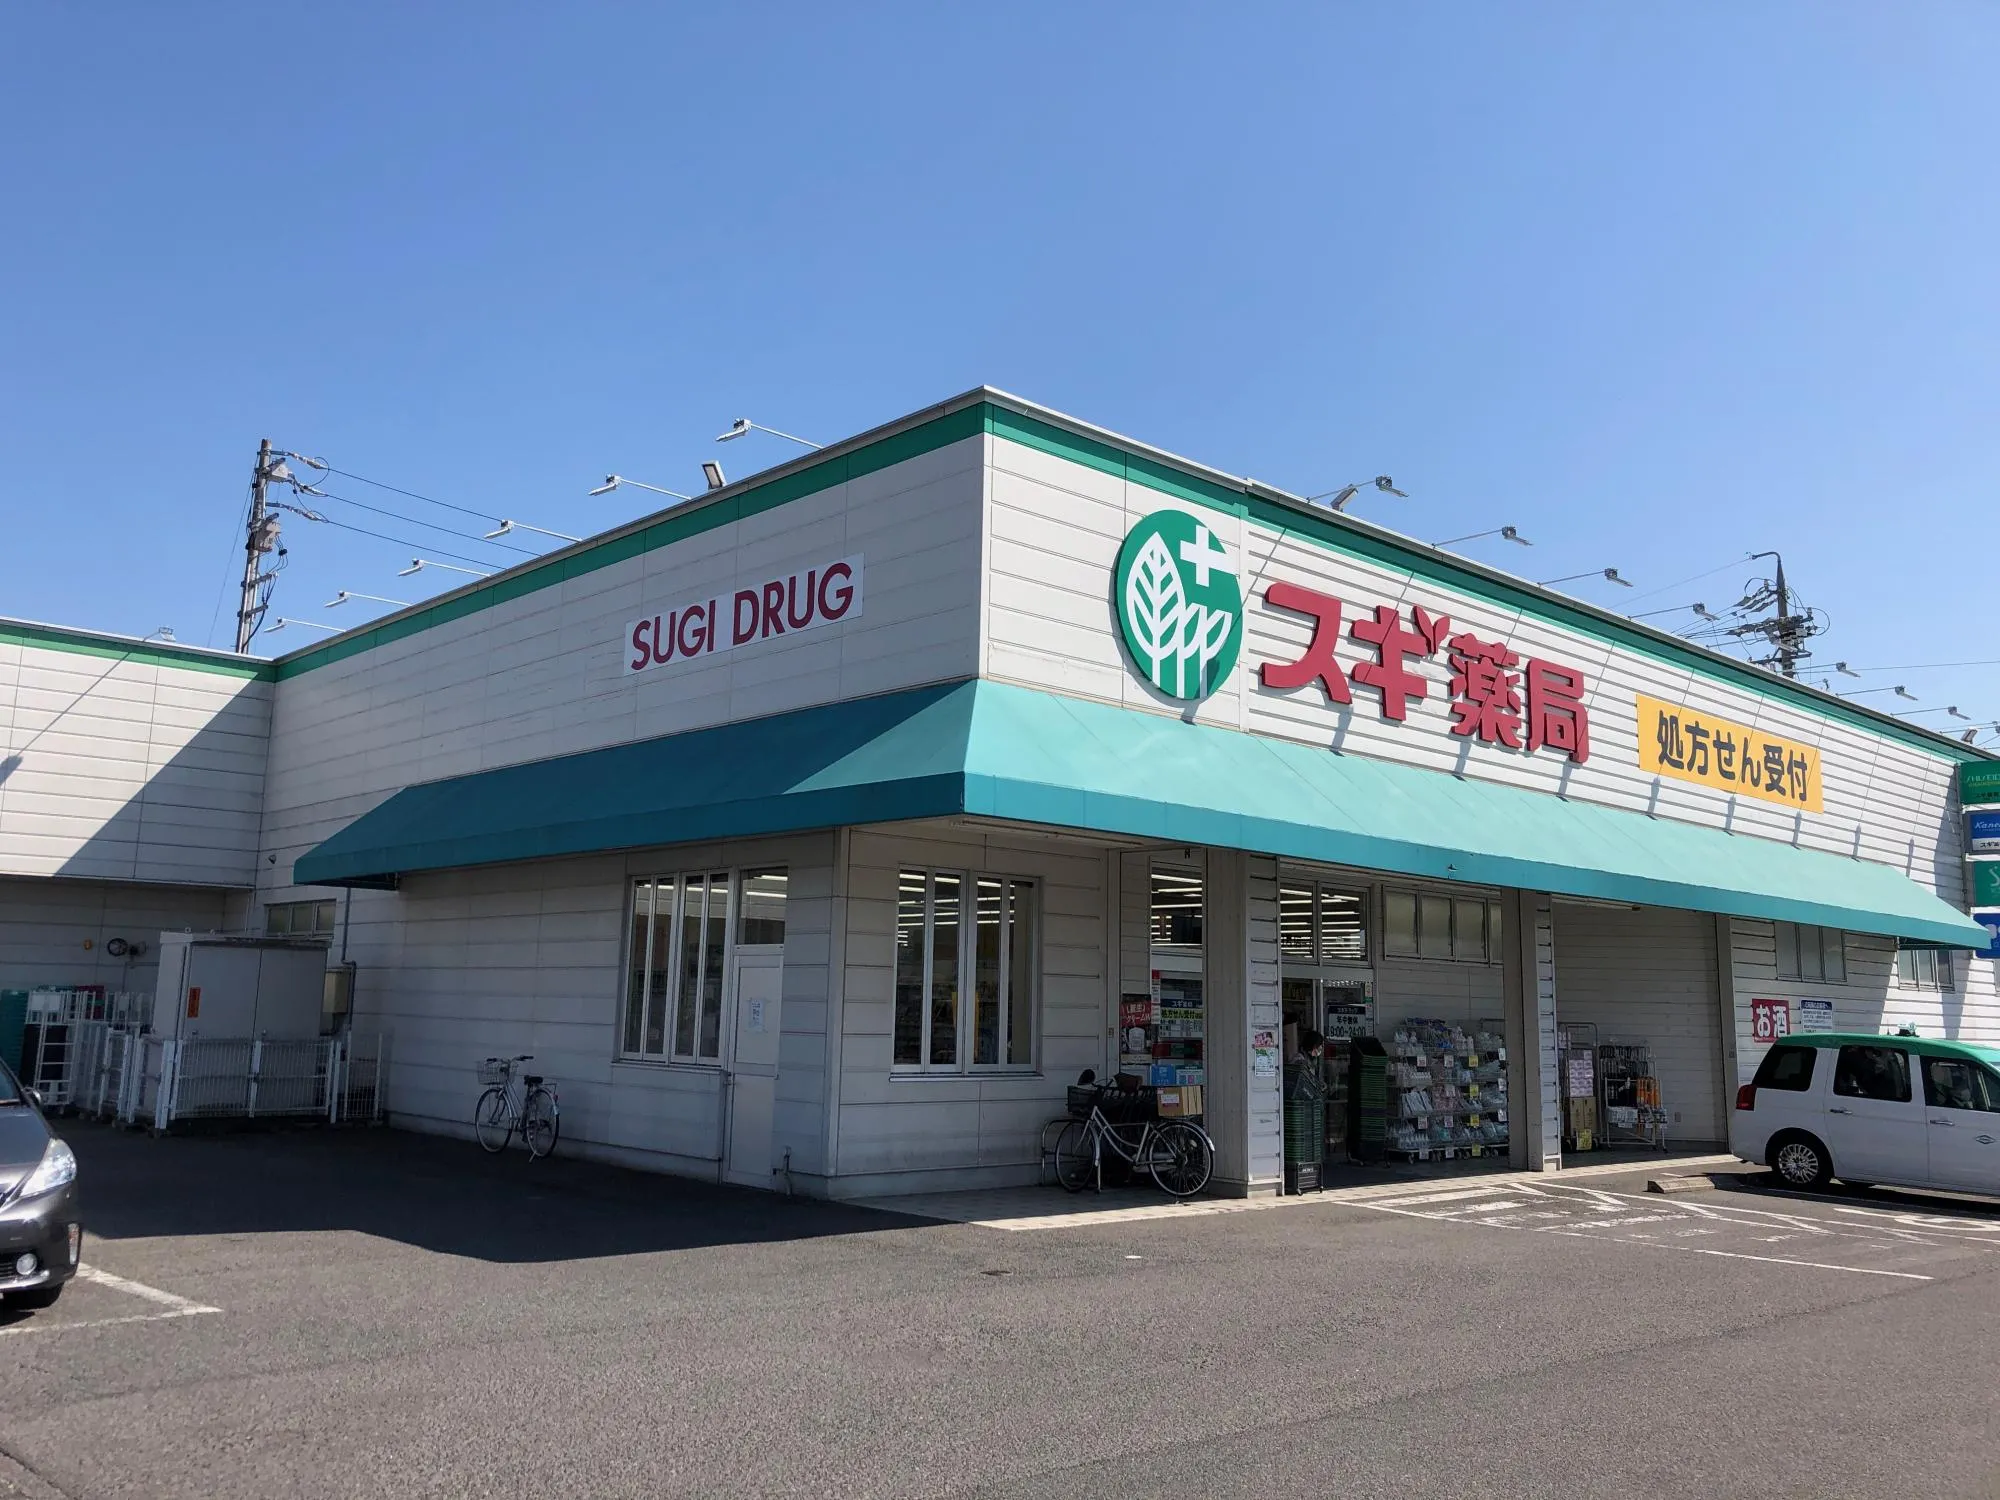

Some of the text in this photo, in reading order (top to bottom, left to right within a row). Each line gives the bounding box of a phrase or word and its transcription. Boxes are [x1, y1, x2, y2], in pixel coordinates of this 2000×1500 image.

[631, 562, 854, 670] SUGI DRUG
[1261, 581, 1589, 764] スギ薬局
[1656, 709, 1808, 802] 処方せん受付
[1755, 1004, 1787, 1038] お酒
